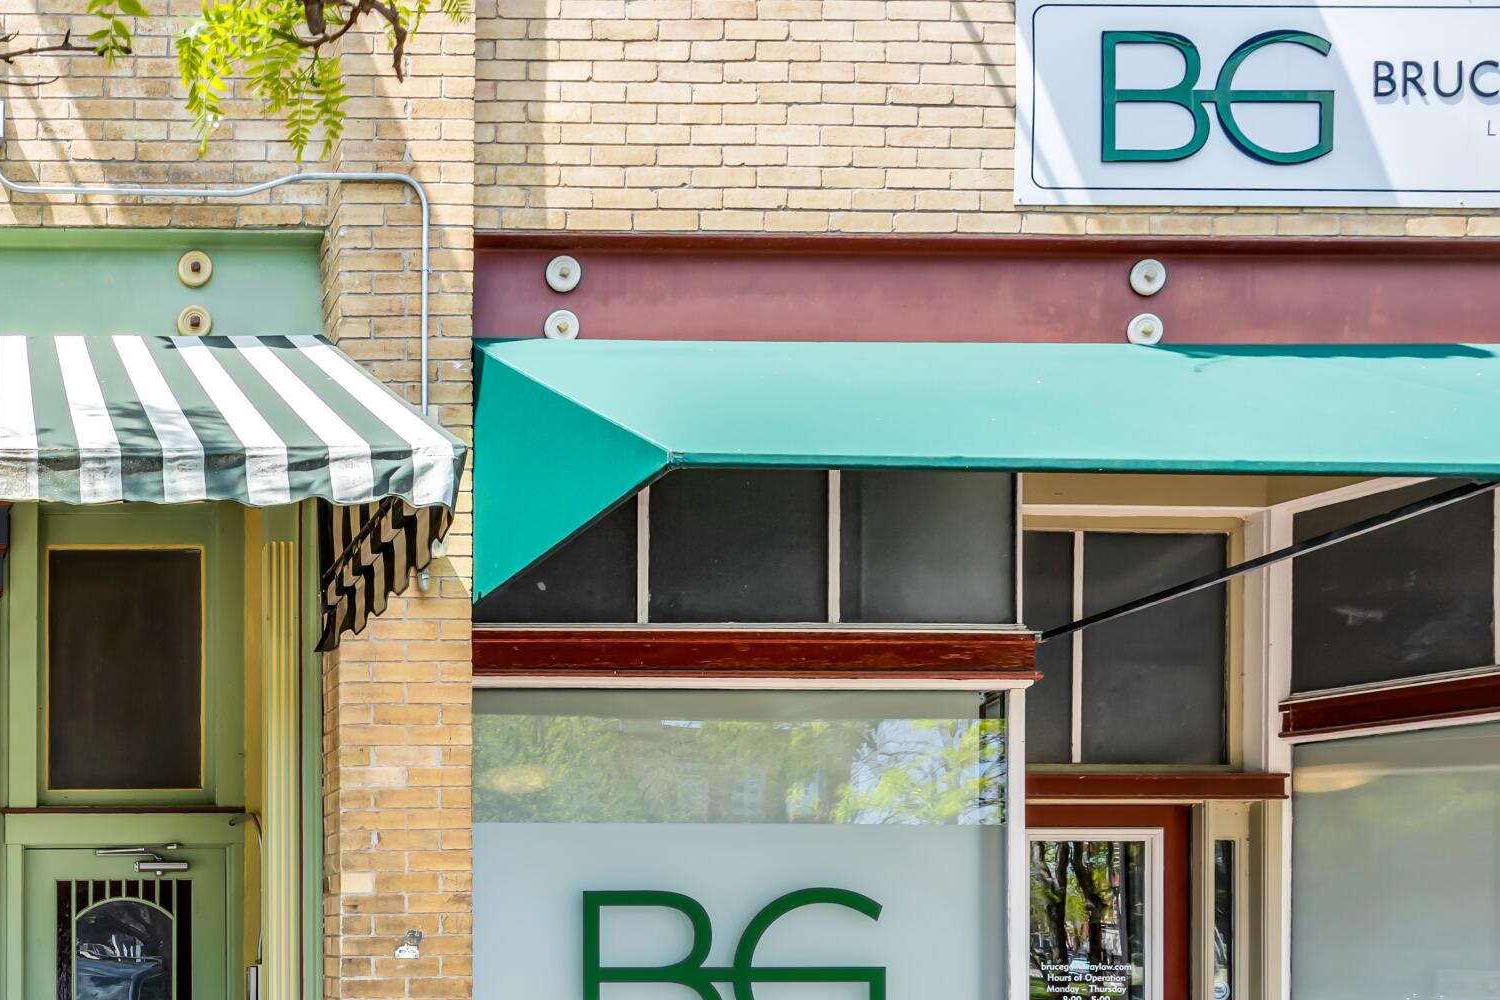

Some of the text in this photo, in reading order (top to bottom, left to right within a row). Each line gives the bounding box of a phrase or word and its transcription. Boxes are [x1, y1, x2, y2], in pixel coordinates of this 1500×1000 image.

[1373, 60, 1500, 98] BRUC
[1101, 29, 1335, 166] BG
[1041, 963, 1132, 973] brucegaylaw.com
[1047, 973, 1126, 984] Hours of Operation
[1046, 985, 1080, 995] Monday
[1088, 984, 1127, 995] Thursday
